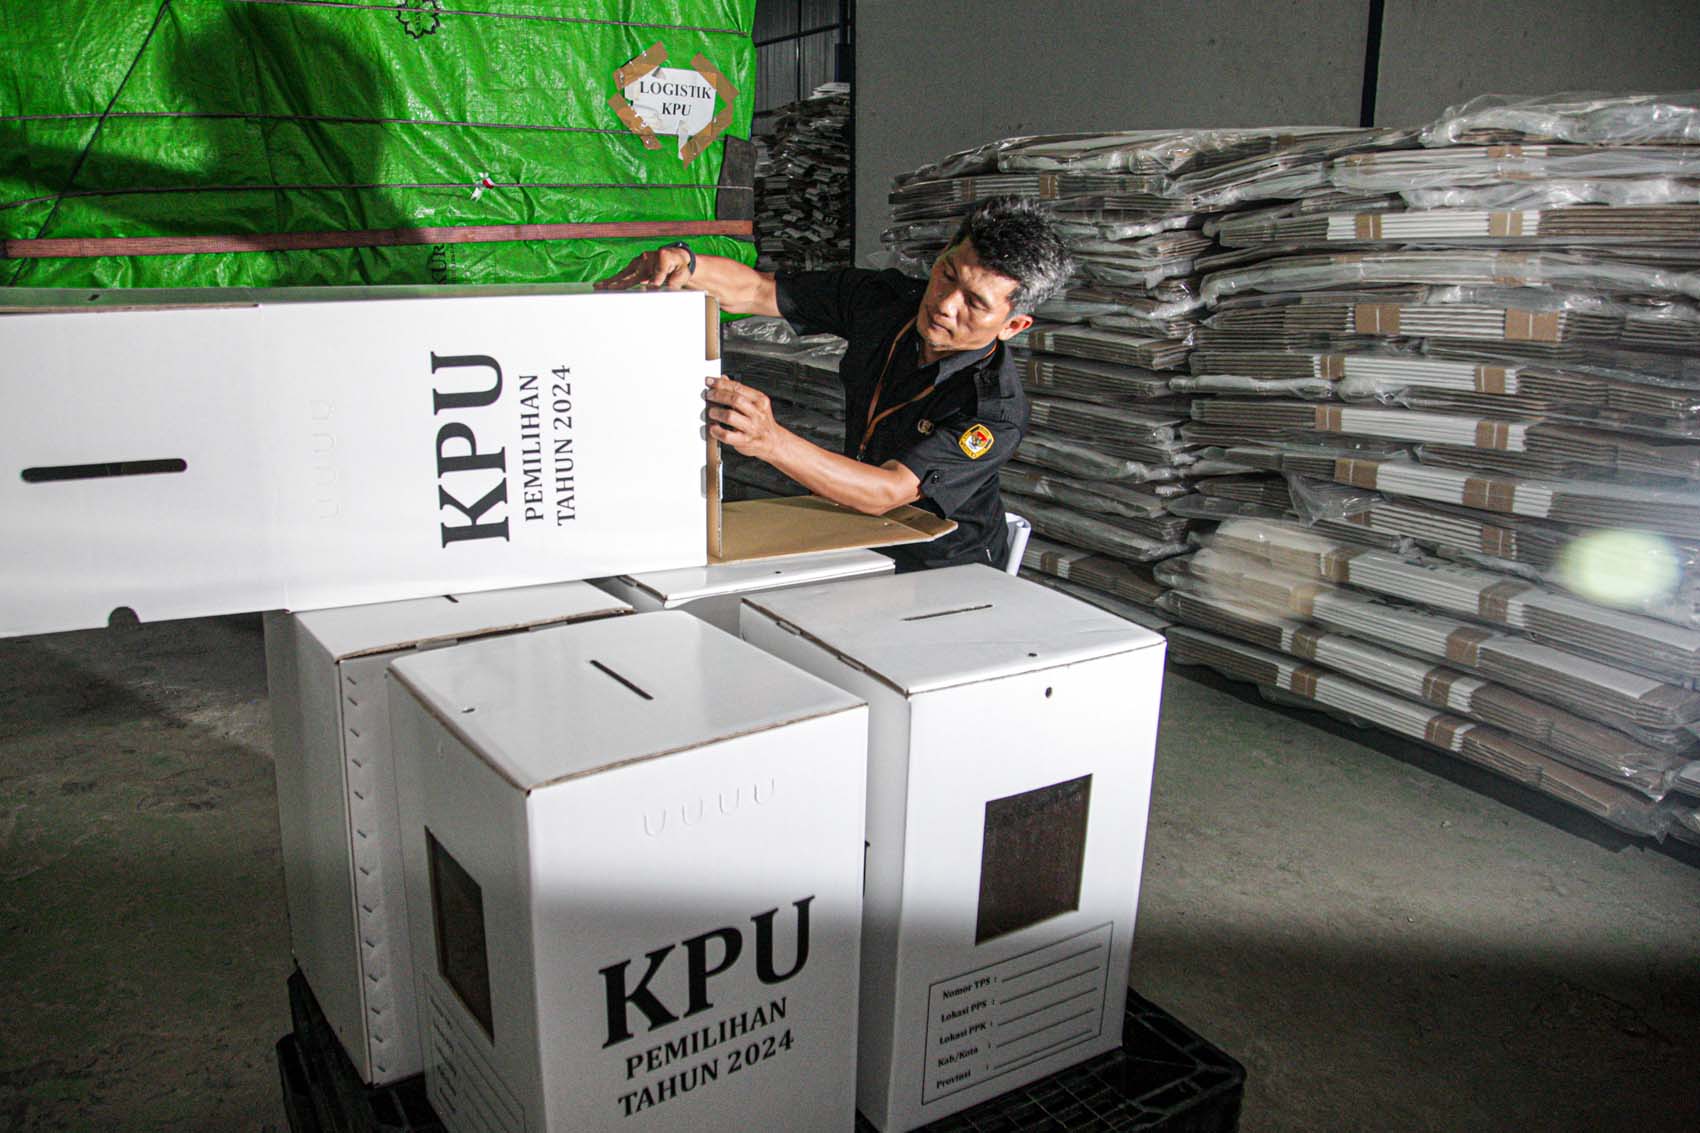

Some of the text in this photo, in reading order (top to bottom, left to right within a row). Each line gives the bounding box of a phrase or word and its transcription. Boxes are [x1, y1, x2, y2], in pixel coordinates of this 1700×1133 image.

[640, 81, 712, 99] LOGISTIK
[662, 103, 692, 117] KPU
[430, 350, 510, 549] KPU
[519, 374, 544, 522] PEMILIHAN
[551, 365, 576, 526] TAHUN 2024
[598, 894, 815, 1049] KPU
[943, 984, 973, 1000] Nomor
[625, 996, 788, 1081] PEMILIHAN
[939, 1028, 968, 1045] Lokasi
[941, 1005, 969, 1023] Lokasi
[618, 1028, 795, 1118] TAHUN 2024
[937, 1069, 971, 1089] Provinsi
